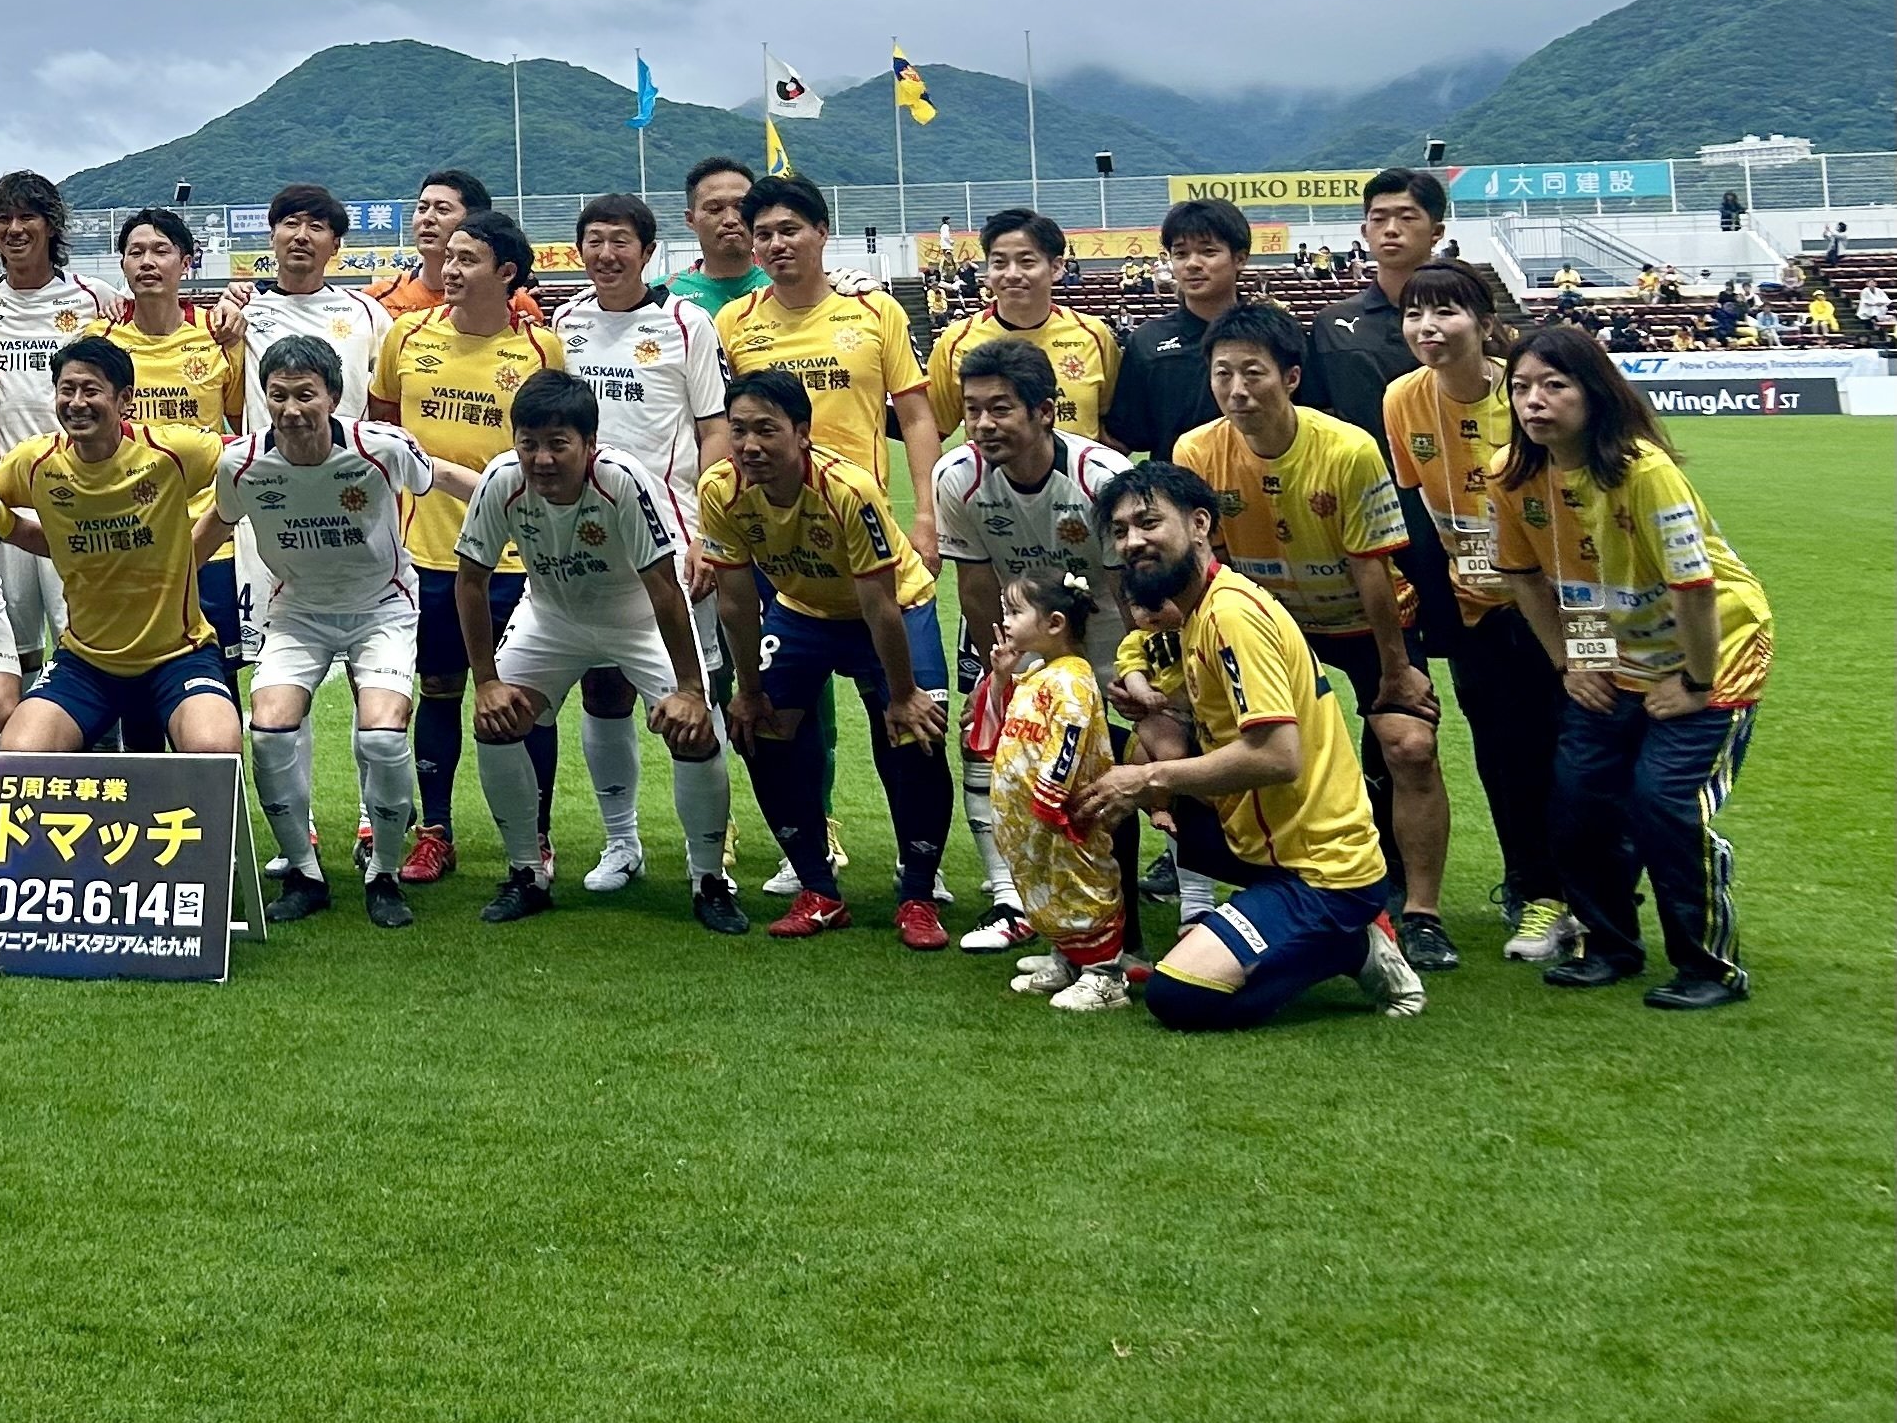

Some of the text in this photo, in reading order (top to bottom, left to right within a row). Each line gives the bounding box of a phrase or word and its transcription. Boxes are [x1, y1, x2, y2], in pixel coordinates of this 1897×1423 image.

[1187, 177, 1361, 203] MOJIKO BEER
[1508, 170, 1635, 195] 大同建設
[0, 340, 59, 350] YASKAWA
[578, 365, 635, 379] YASKAWA
[1707, 360, 1768, 372] Challenging
[431, 387, 496, 405] YASKAWA
[420, 399, 503, 428] 安川電機
[75, 515, 141, 532] YASKAWA
[283, 516, 351, 529] YASKAWA
[68, 526, 155, 554] 安川電機
[277, 527, 366, 550] 安川電機
[1568, 621, 1607, 633] STAFF
[179, 891, 199, 918] SAT
